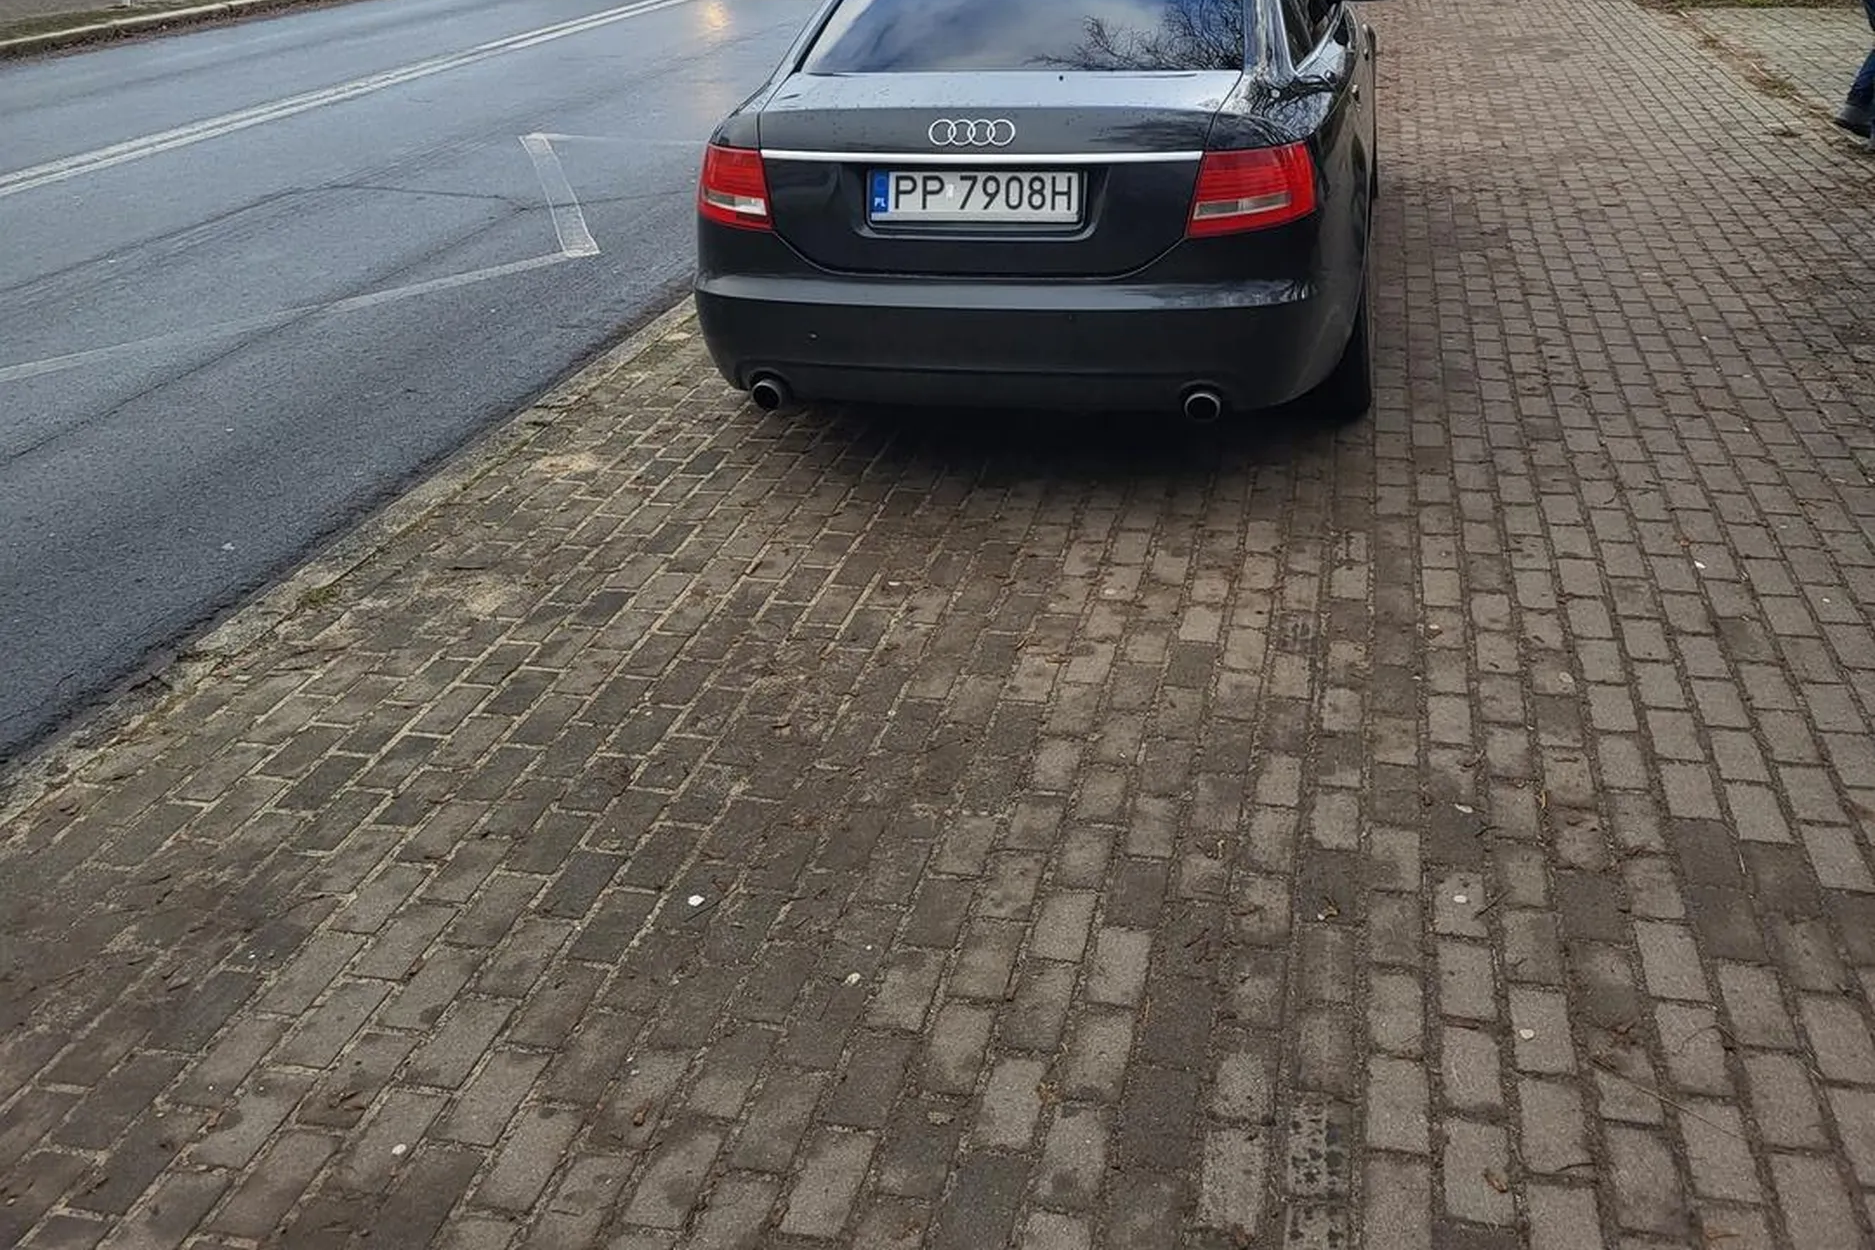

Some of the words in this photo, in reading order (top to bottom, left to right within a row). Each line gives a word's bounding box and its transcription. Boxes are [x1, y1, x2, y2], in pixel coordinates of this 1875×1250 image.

[874, 197, 886, 207] PL
[894, 175, 945, 211] PP
[958, 175, 1073, 212] 7908H
